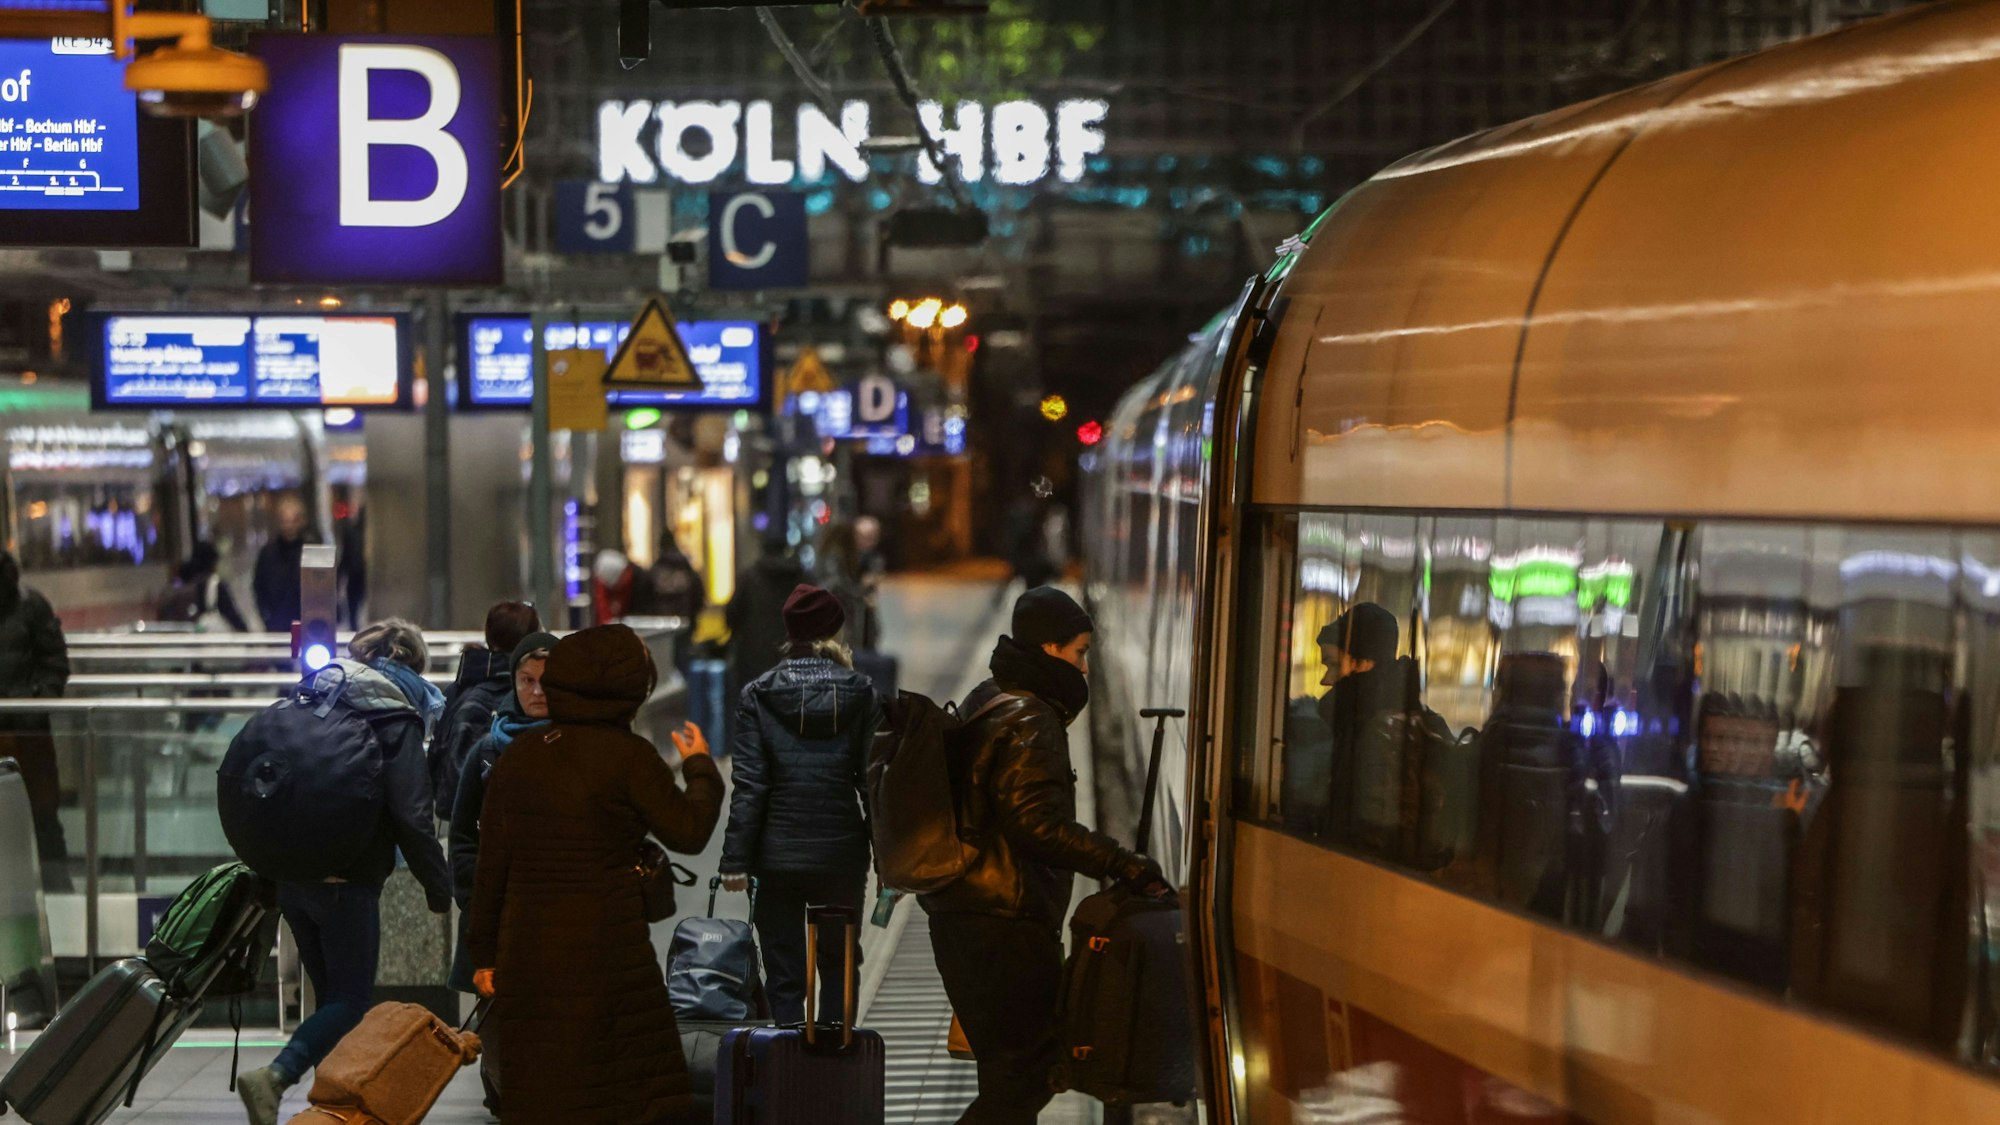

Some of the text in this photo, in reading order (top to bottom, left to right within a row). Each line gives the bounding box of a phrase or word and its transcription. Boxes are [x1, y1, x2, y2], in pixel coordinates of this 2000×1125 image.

[1, 69, 31, 101] of
[10, 137, 32, 151] Hbf
[44, 137, 80, 152] Berlin
[81, 138, 103, 152] Hbf
[25, 118, 73, 133] Bochum
[74, 119, 97, 134] Hbf
[339, 43, 469, 227] B
[599, 99, 1109, 185] KÖLN HBF
[584, 182, 622, 239] 5
[720, 194, 776, 269] C
[859, 375, 895, 422] D
